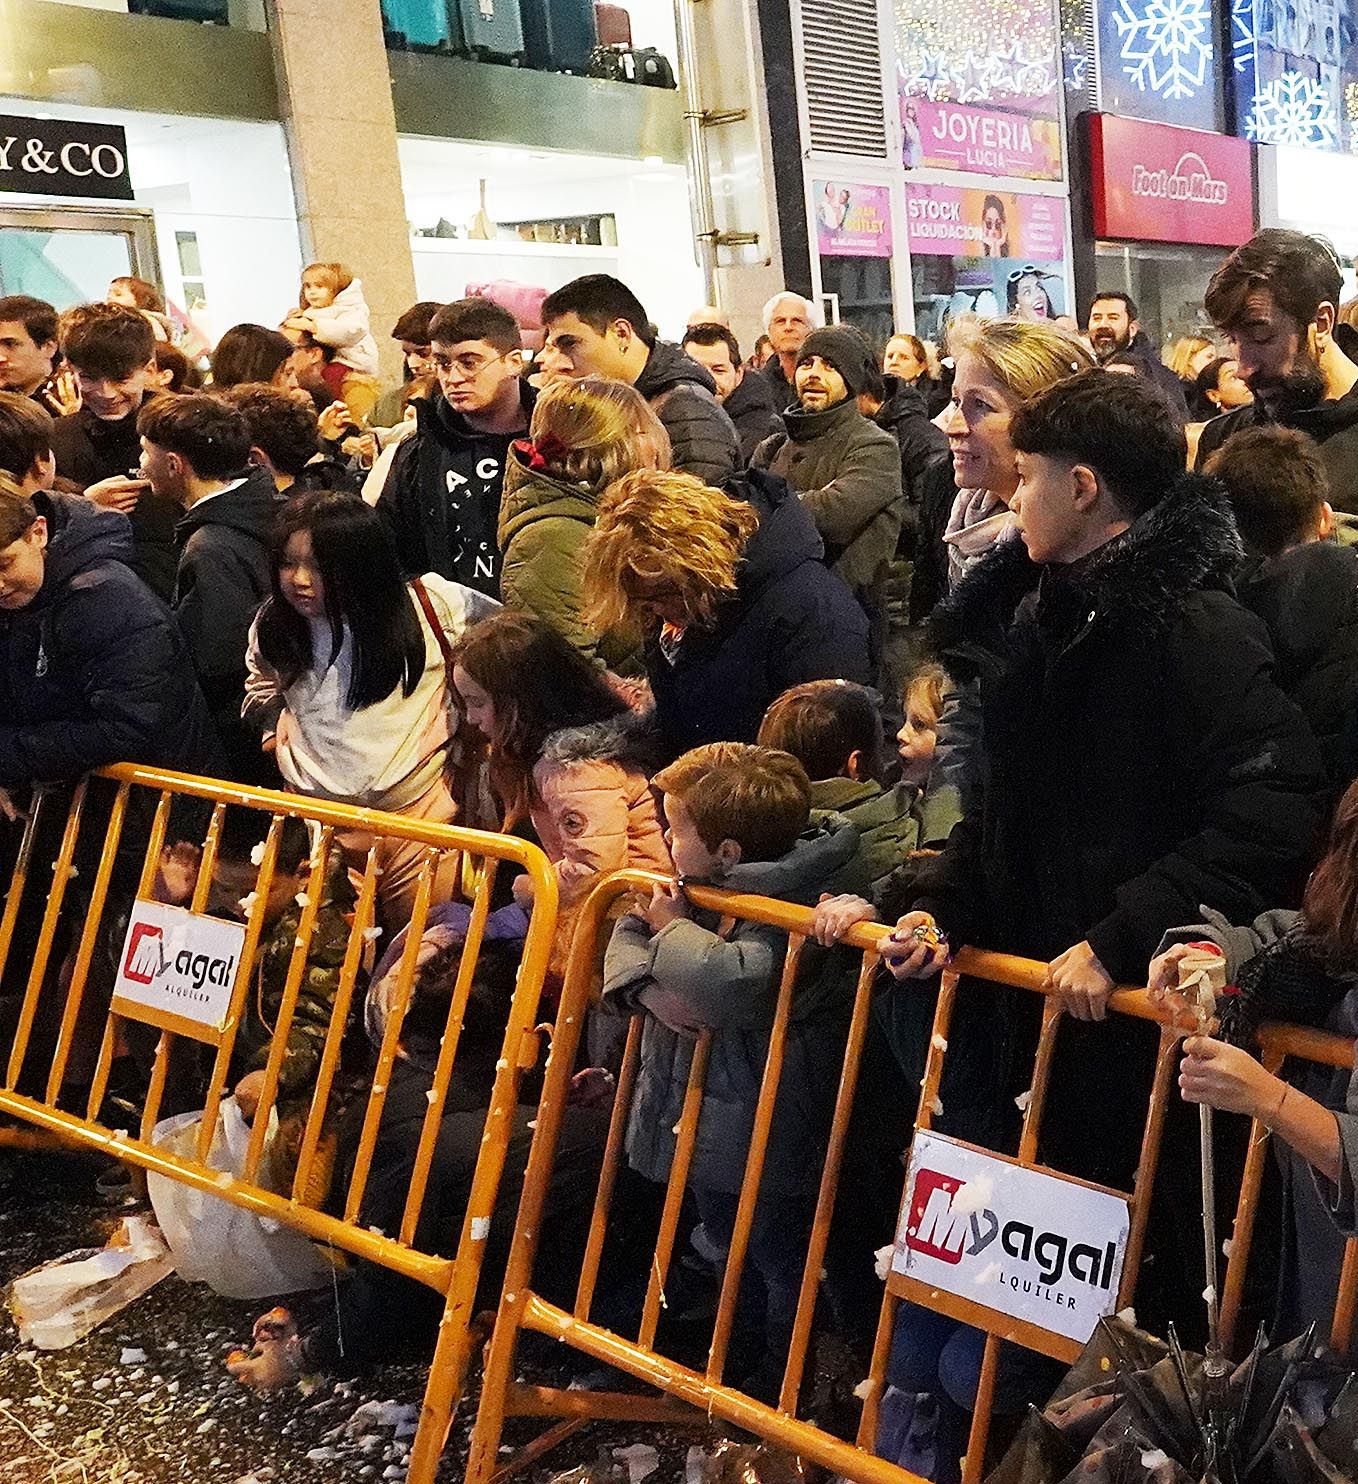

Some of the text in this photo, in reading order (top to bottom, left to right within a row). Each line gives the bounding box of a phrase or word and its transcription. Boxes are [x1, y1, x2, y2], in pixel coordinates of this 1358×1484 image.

[932, 110, 1033, 154] JOYERIA
[966, 147, 1006, 169] LUCIA
[1132, 165, 1168, 198] Foot
[1189, 172, 1229, 205] Mars
[909, 199, 961, 221] STOCK
[476, 458, 499, 479] C
[911, 1176, 1118, 1290] Myagal
[998, 1271, 1077, 1311] LQUILER
